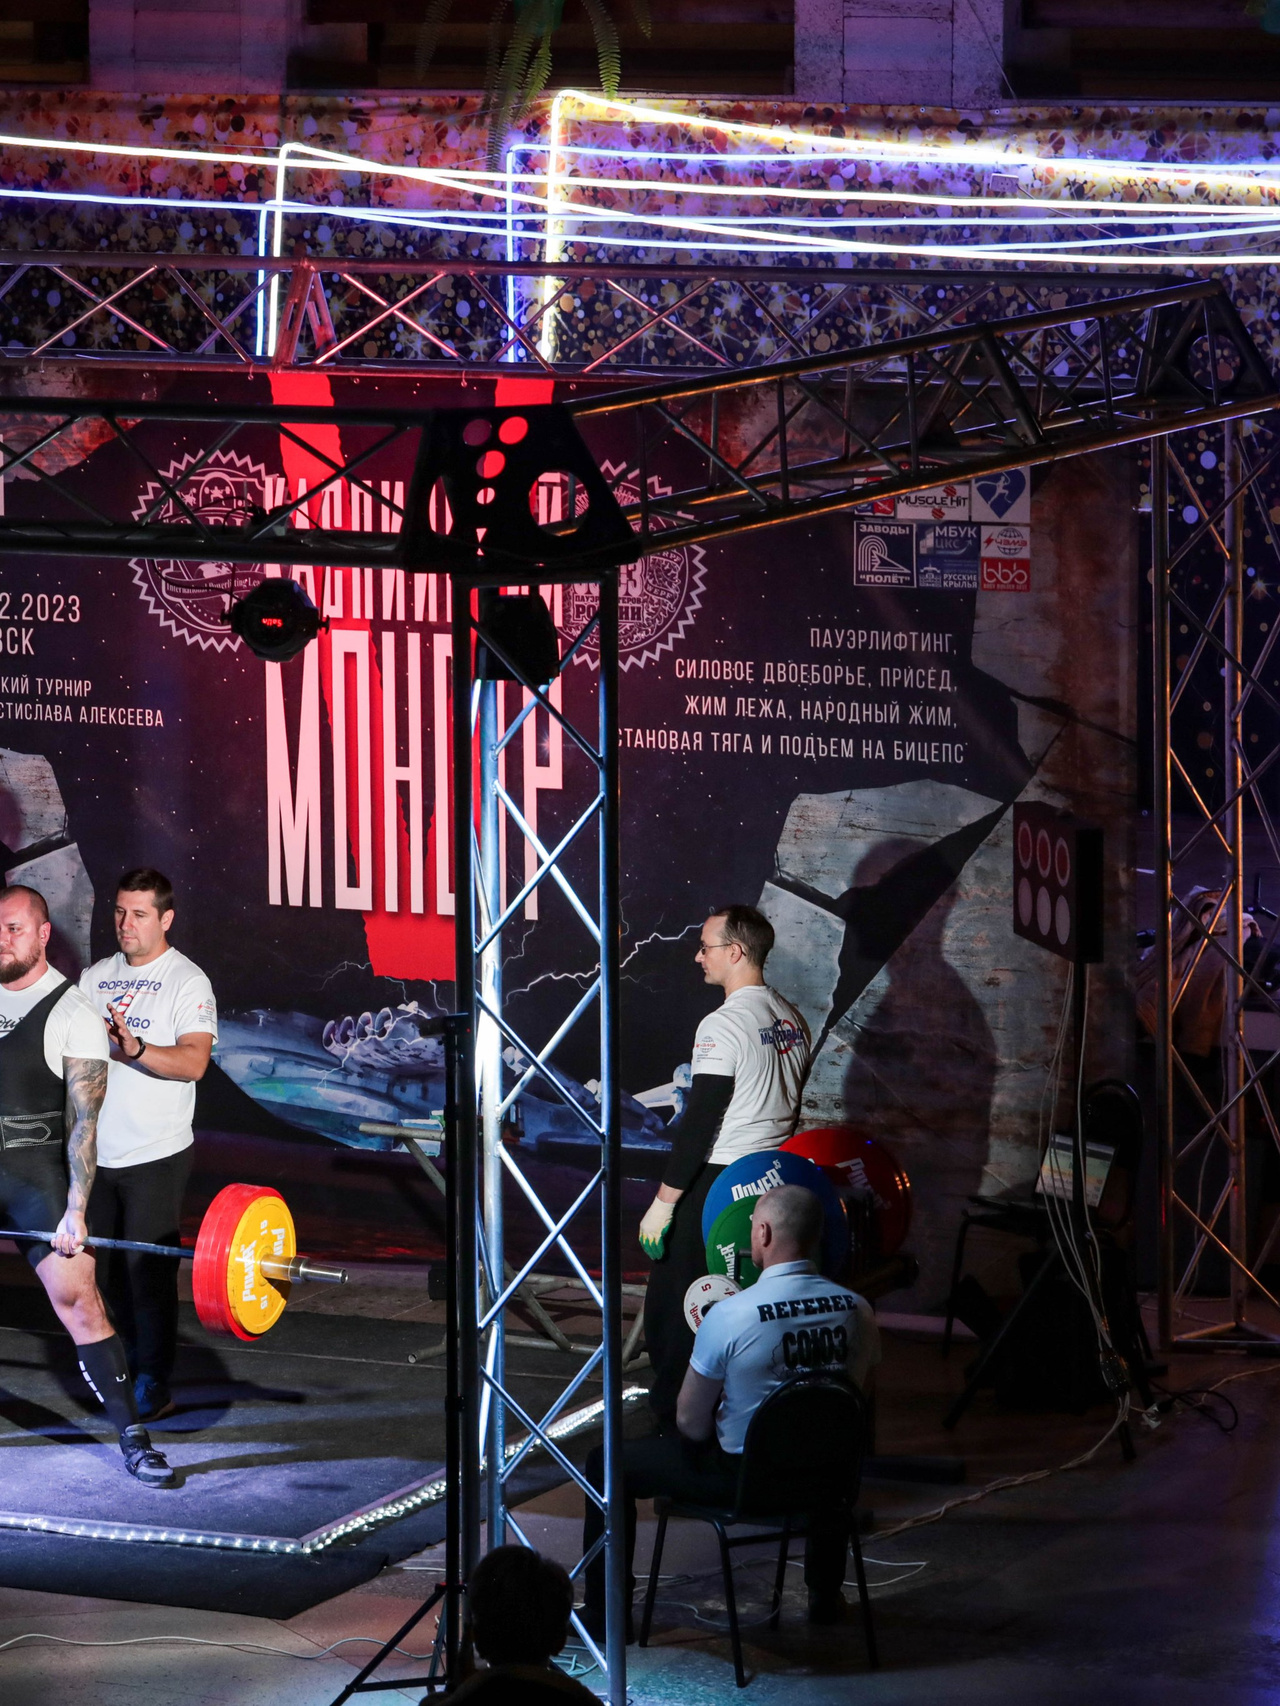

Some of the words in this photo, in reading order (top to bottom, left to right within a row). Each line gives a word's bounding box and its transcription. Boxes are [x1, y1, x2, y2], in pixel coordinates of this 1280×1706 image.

[897, 495, 948, 507] MUSCLE
[859, 524, 910, 535] ЗАВОДЫ
[935, 526, 977, 538] МБУК
[935, 539, 960, 551] ЦКС
[944, 573, 978, 582] РУССКИЕ
[944, 580, 978, 589] КРЫЛЬЯ
[810, 628, 957, 654] ПАУЭРЛИФТИНГ,
[675, 658, 754, 681] СИЛОВОЕ
[763, 662, 872, 688] ДВОЕБОРЬЕ,
[880, 667, 958, 692] ПРИСЕД,
[36, 678, 92, 697] ТУРНИР
[80, 706, 164, 727] АЛЕКСЕЕВА
[684, 694, 727, 716] ЖИМ
[735, 697, 792, 721] ЛЕЖА,
[801, 700, 900, 724] НАРОДНЫЙ
[908, 704, 957, 728] ЖИМ,
[711, 732, 753, 754] ТЯГА
[762, 734, 772, 754] И
[780, 735, 854, 759] ПОДЪЕМ
[862, 739, 885, 760] НА
[894, 740, 964, 764] БИЦЕПС
[98, 980, 162, 992] ФОРЭНЕРГО
[701, 1283, 712, 1292] 5
[756, 1294, 858, 1323] REFEREE
[782, 1325, 848, 1370] СОЮЗ
